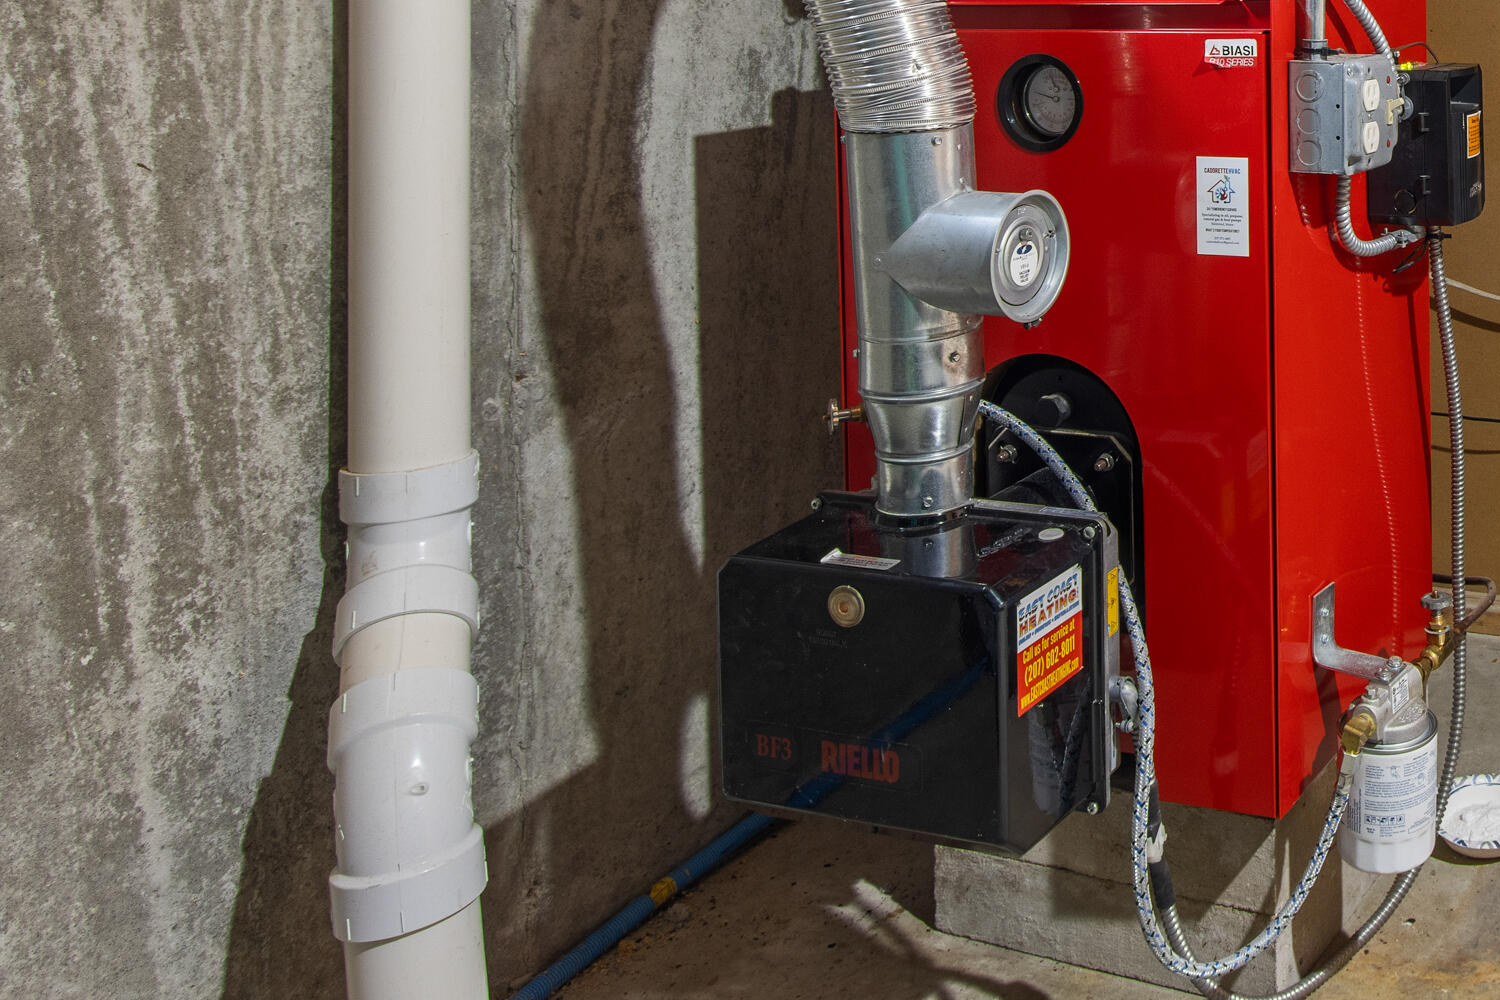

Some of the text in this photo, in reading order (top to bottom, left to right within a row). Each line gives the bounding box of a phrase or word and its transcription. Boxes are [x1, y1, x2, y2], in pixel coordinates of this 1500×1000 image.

[1222, 45, 1254, 56] BIASI
[1226, 57, 1254, 68] SERIES
[1018, 573, 1078, 623] EAST COAST
[1019, 588, 1078, 637] HEATING
[1023, 617, 1075, 665] Call us for service at
[1024, 633, 1076, 688] (207) 602-8011
[756, 733, 793, 762] BF3
[821, 739, 901, 784] RIELLO
